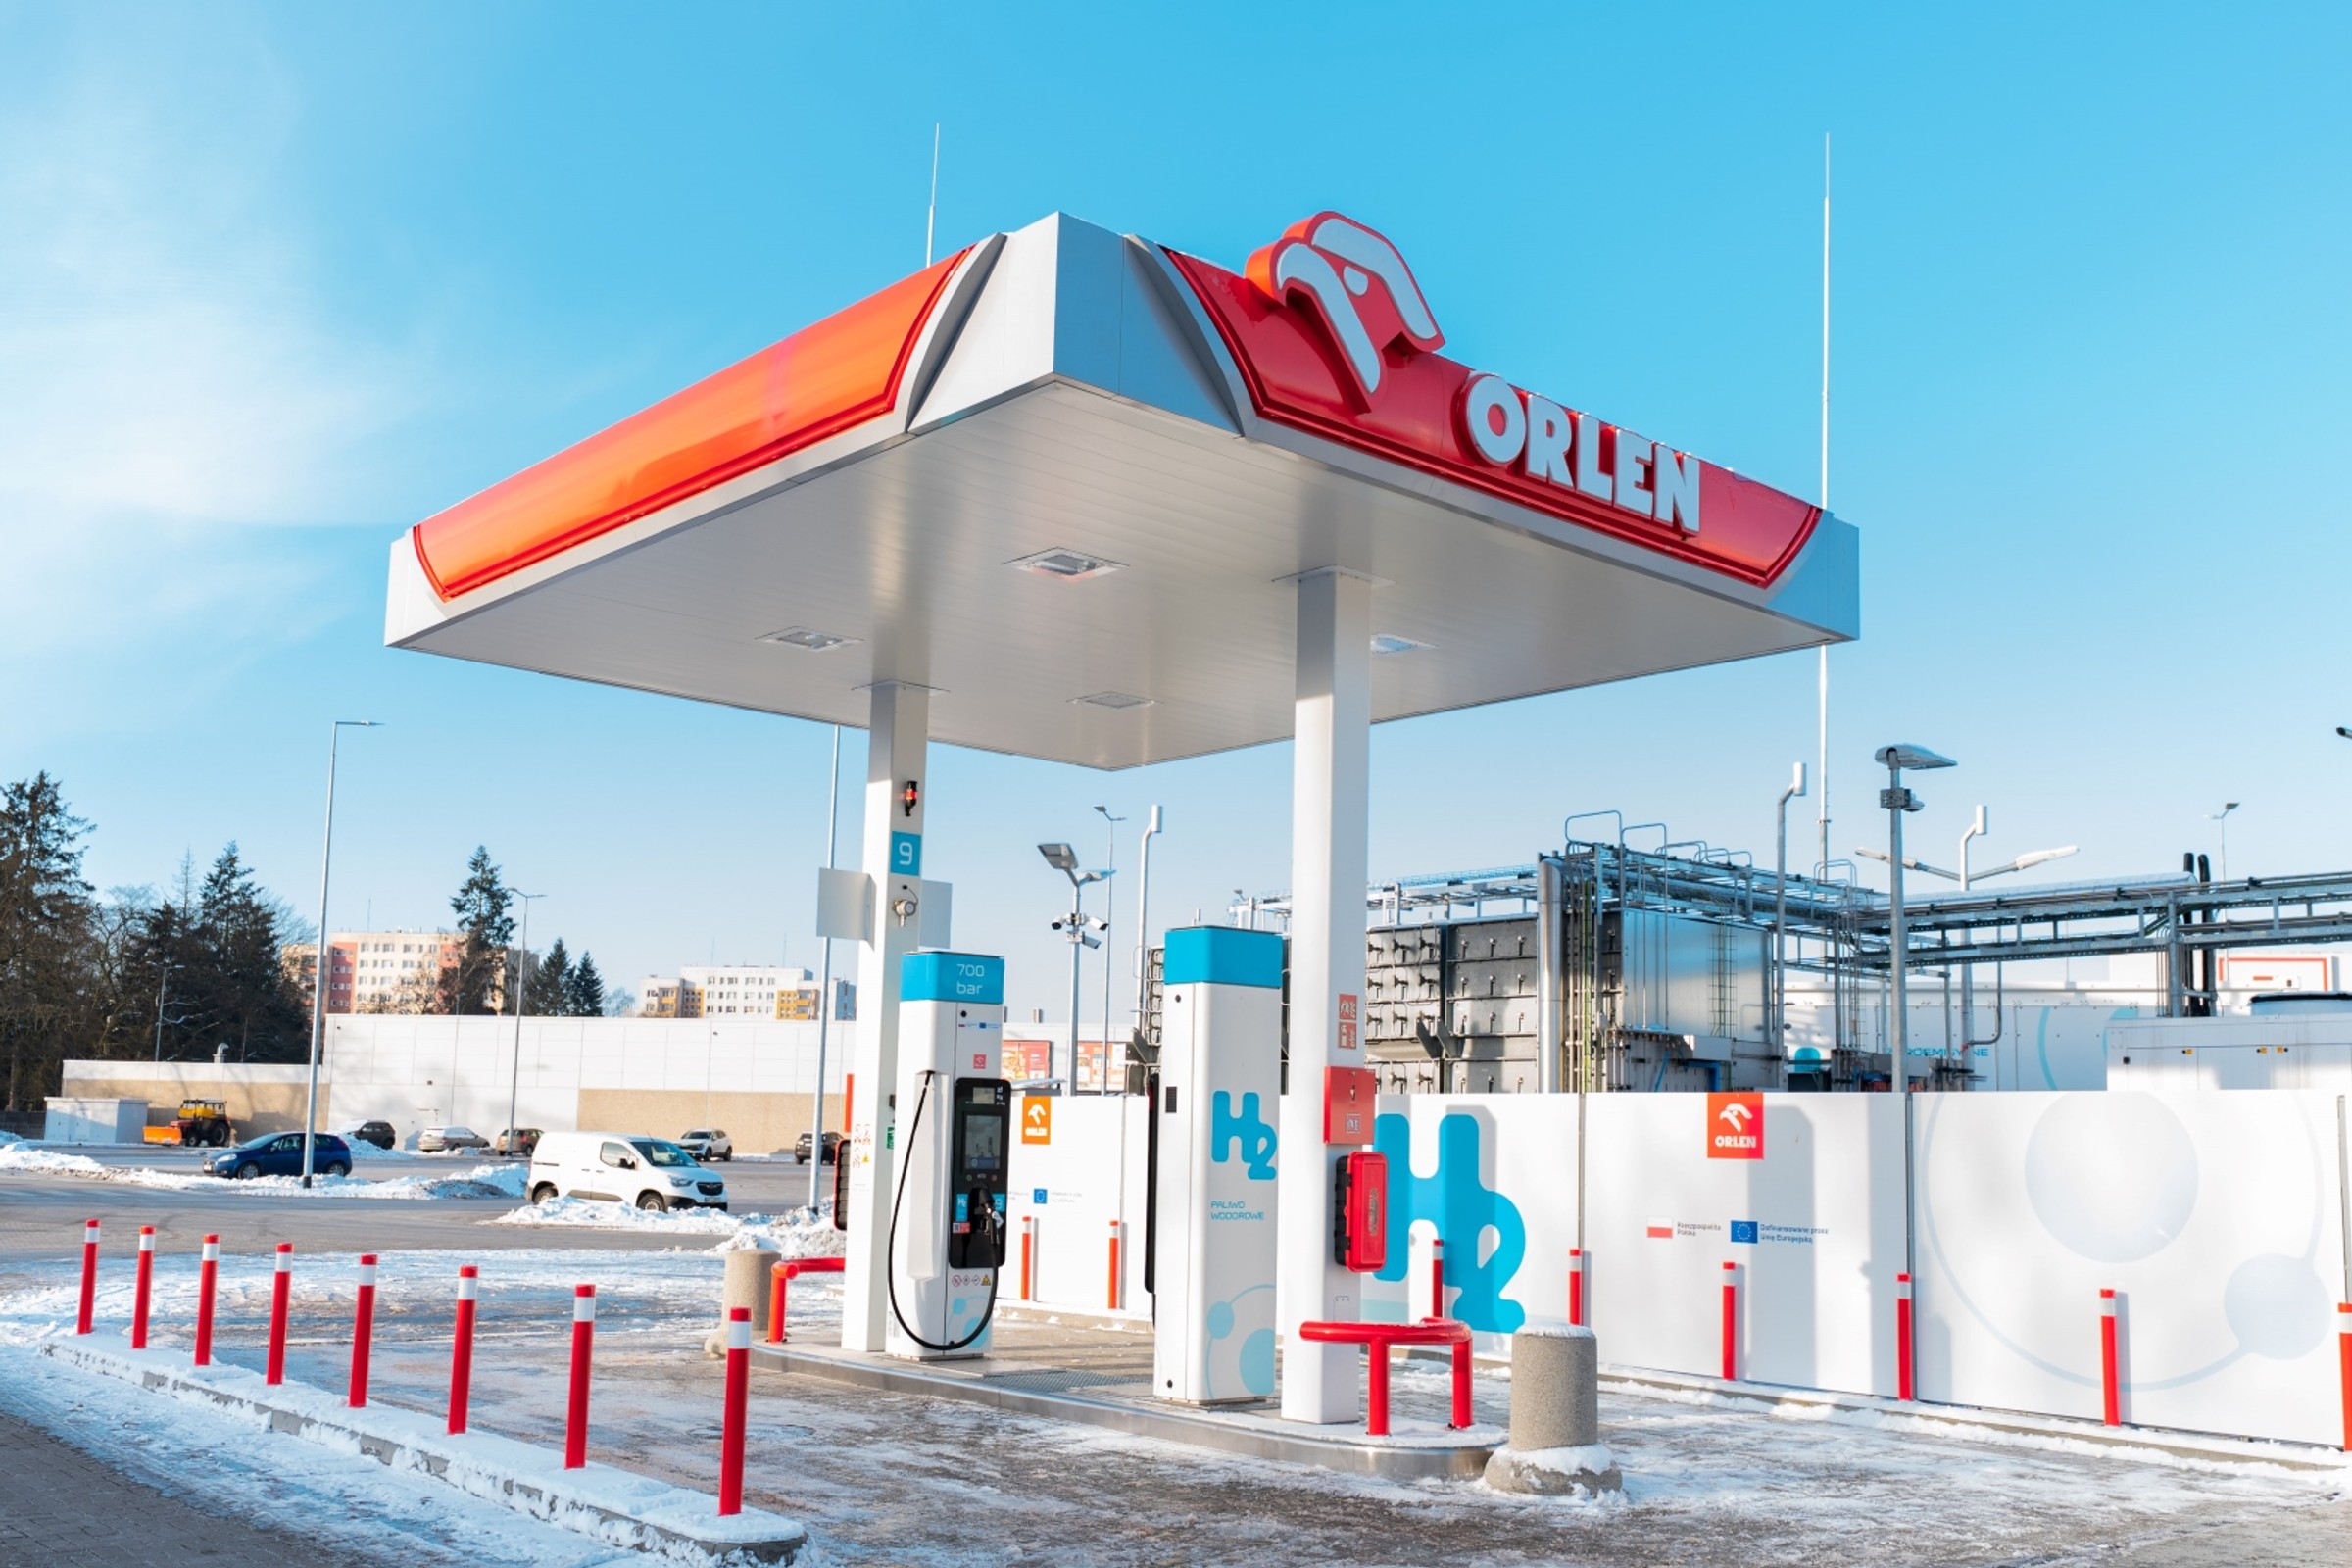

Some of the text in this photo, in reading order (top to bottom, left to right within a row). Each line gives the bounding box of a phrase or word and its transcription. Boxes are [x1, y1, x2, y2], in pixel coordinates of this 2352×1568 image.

[1466, 374, 1700, 532] ORLEN
[899, 841, 913, 866] 9
[956, 963, 985, 978] 700
[956, 981, 984, 995] bar
[1211, 1090, 1278, 1180] H2
[1715, 1135, 1757, 1149] ORLEN
[1210, 1200, 1246, 1209] PALIWO
[1210, 1212, 1264, 1221] WODOROWE
[1372, 1113, 1526, 1334] H2
[1760, 1224, 1809, 1234] Dofinansowane
